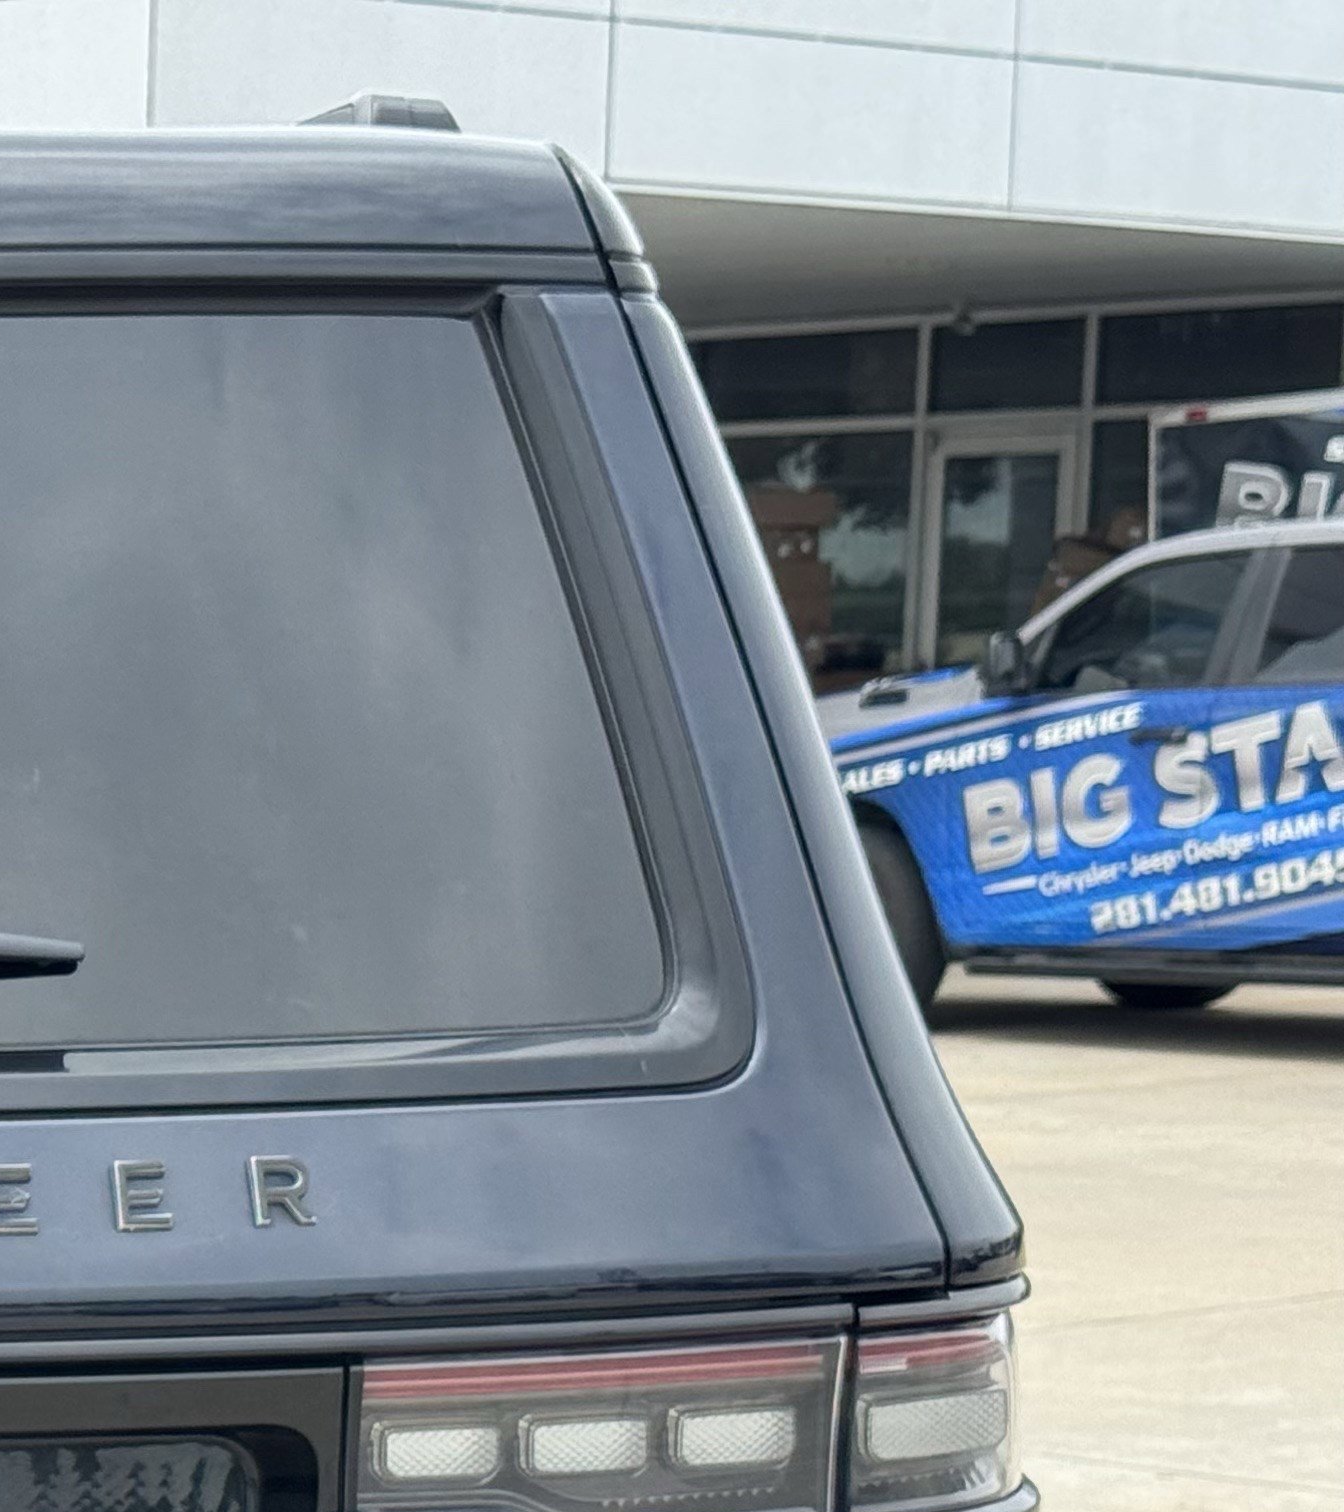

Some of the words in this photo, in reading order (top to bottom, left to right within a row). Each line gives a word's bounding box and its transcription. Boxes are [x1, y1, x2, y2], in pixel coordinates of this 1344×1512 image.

[842, 757, 906, 794] ALES
[924, 733, 1012, 777] PARTS
[1034, 702, 1143, 750] SERVICE
[962, 753, 1132, 874] BIG
